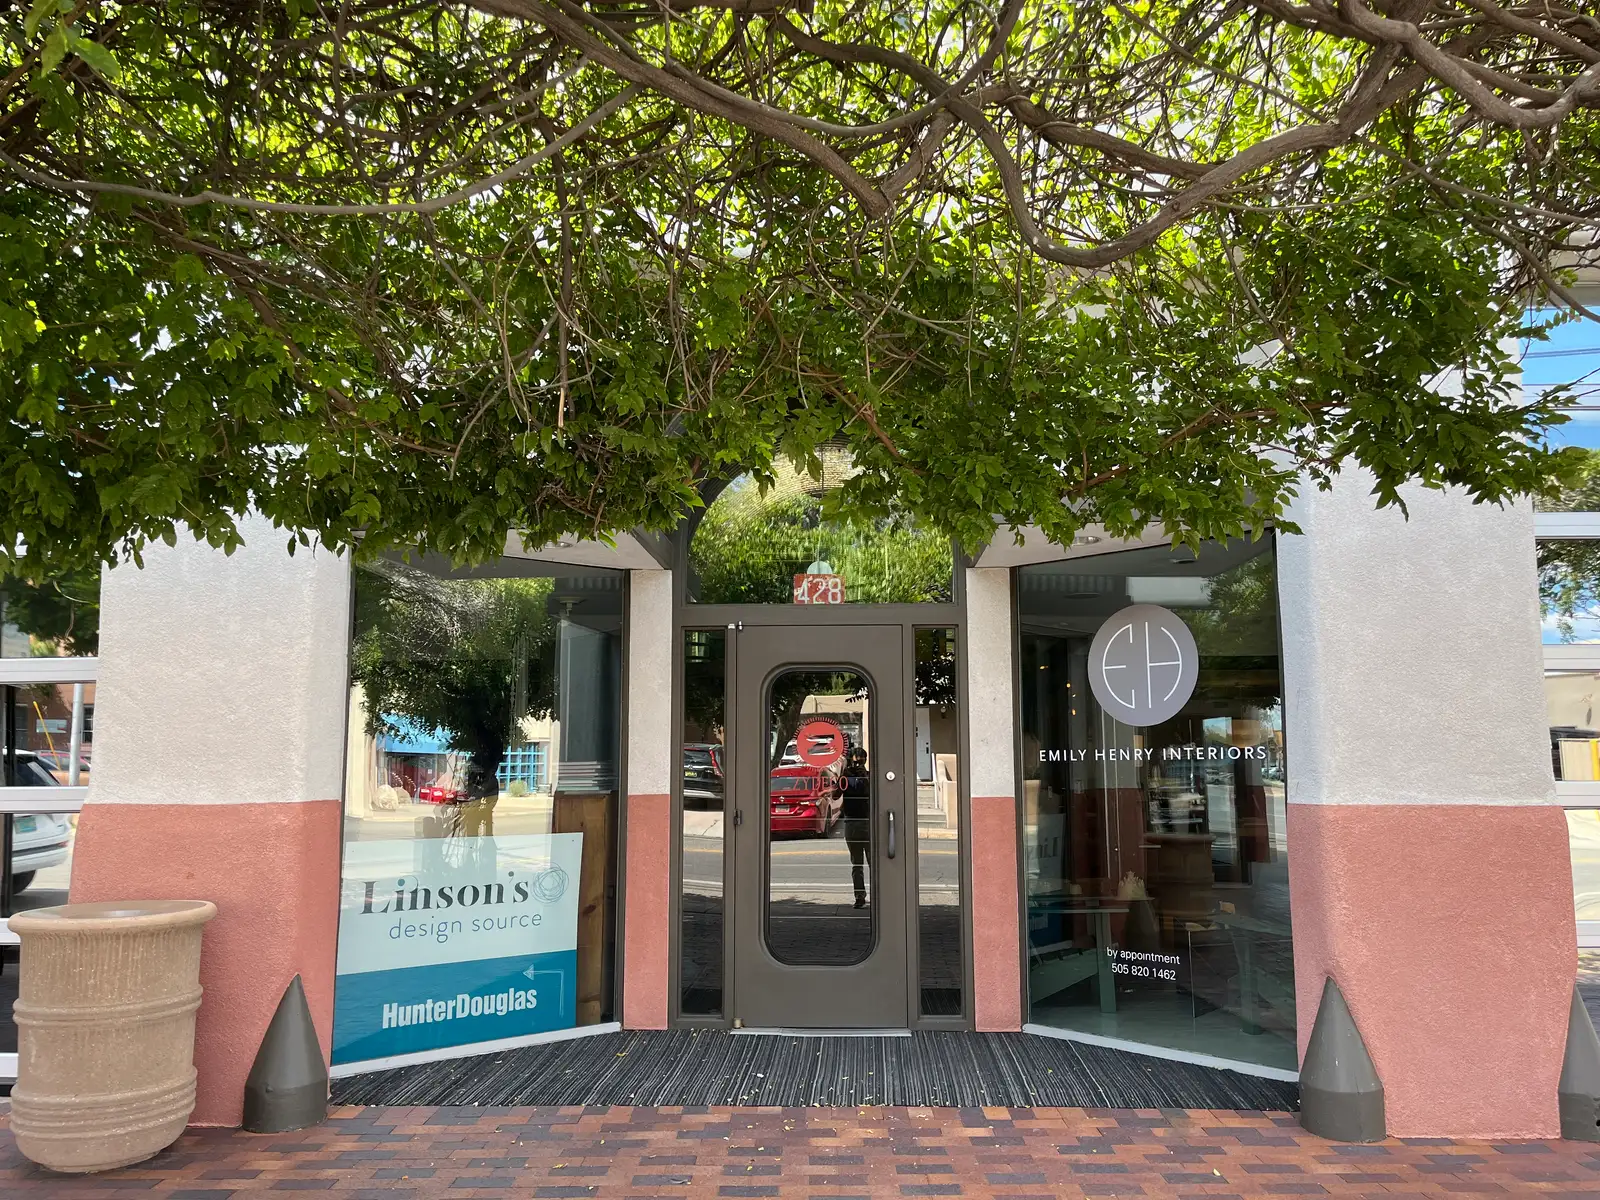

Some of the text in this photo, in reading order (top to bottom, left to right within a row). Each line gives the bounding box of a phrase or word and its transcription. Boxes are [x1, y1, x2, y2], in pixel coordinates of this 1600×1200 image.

[797, 577, 842, 604] 428
[1039, 746, 1267, 762] EMILY HENRY INTERIORS
[793, 775, 849, 791] ZYDECO
[360, 871, 529, 914] Linson's
[389, 913, 542, 943] design source
[1106, 946, 1180, 964] by appointment
[1111, 962, 1177, 981] 505 820 1462
[382, 988, 537, 1029] HunterDouglas
